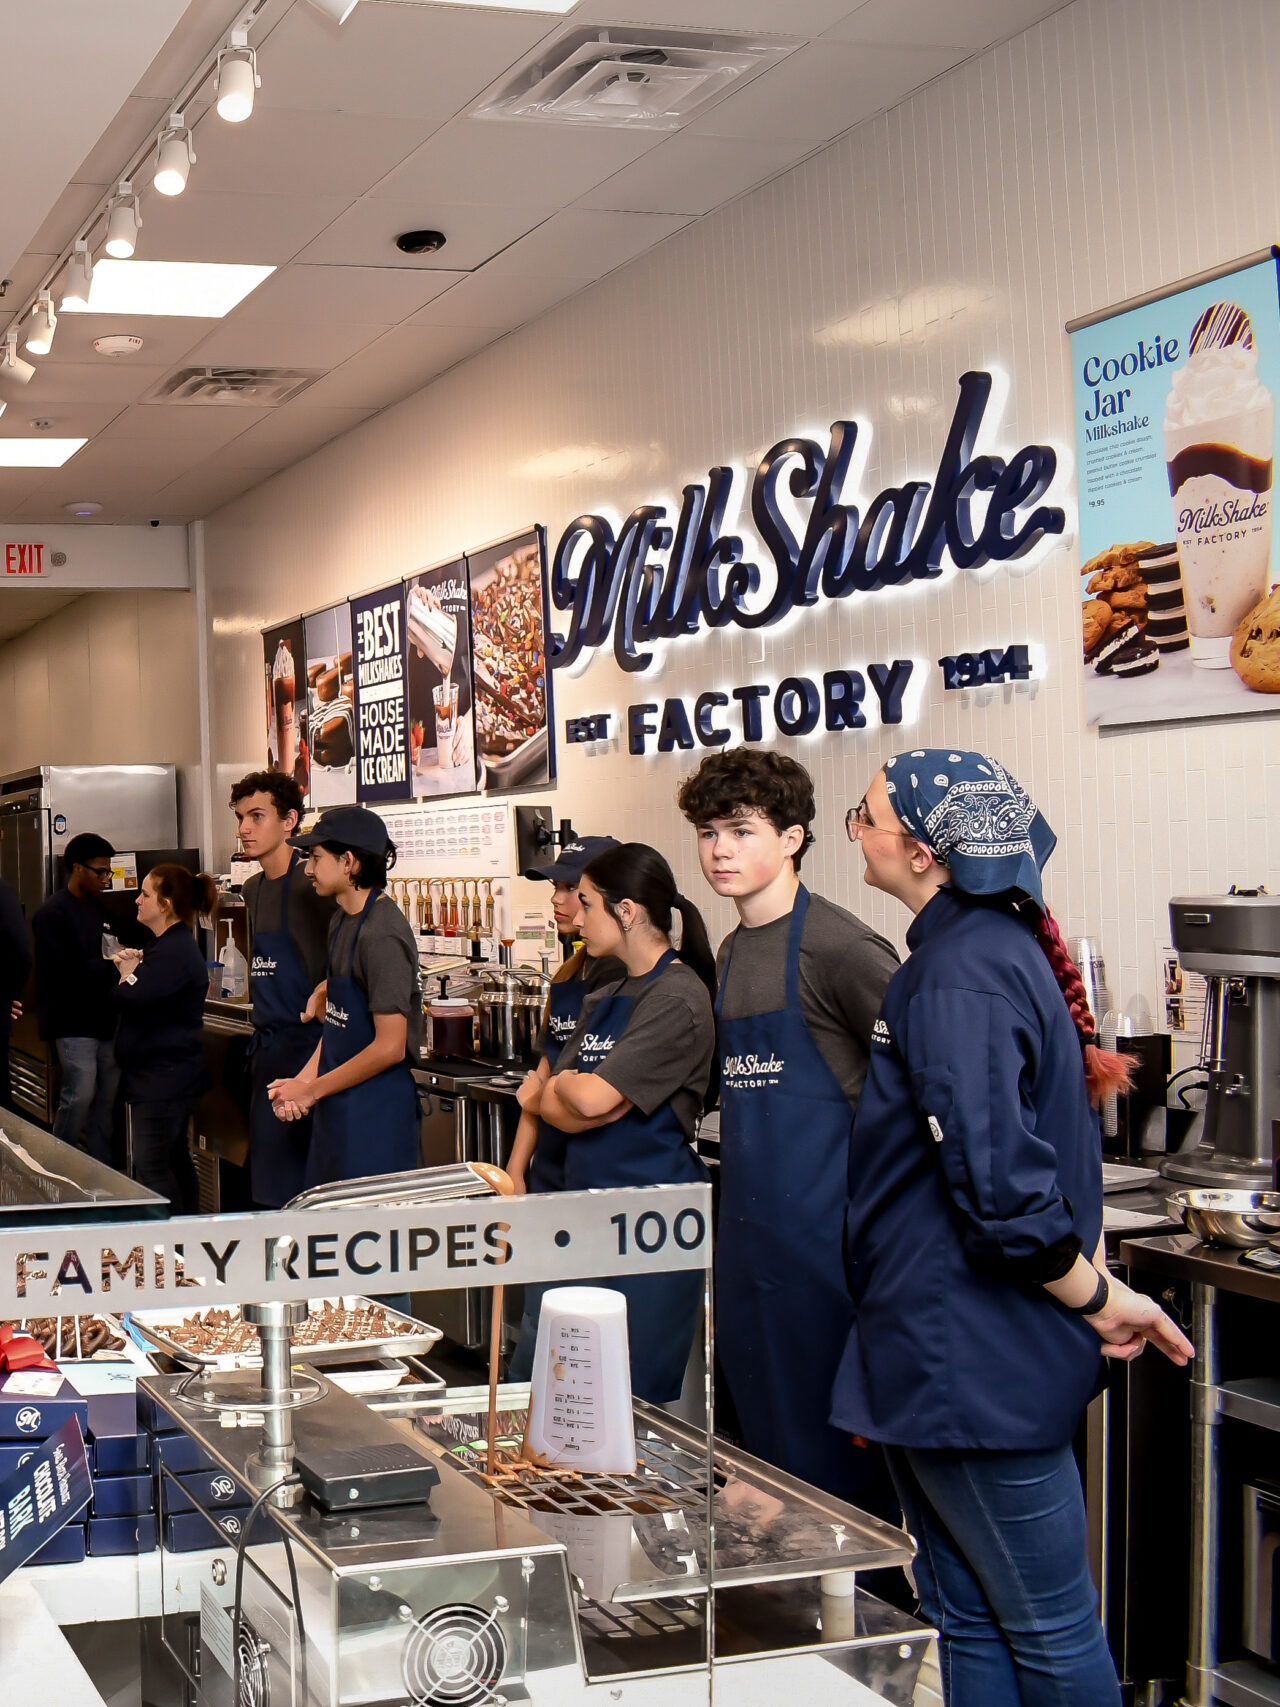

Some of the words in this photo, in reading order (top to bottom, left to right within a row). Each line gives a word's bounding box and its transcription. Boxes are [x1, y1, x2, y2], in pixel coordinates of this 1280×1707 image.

[1083, 335, 1180, 387] Cookie
[1084, 388, 1131, 421] Jar
[1085, 415, 1150, 443] Milkshake
[551, 371, 1066, 672] MilkShake
[1177, 494, 1268, 533] MilkShake
[1197, 530, 1247, 546] FACTORY
[6, 544, 44, 573] EXIT
[363, 599, 401, 661] BEST
[358, 654, 403, 687] MILKSHAKES
[359, 698, 404, 728] HOUSE
[628, 659, 914, 755] FACTORY
[938, 644, 1033, 691] 1914
[359, 723, 405, 756] MADE
[361, 755, 377, 785] ICE
[376, 752, 406, 784] CREAM
[729, 1079, 767, 1089] FACTORY
[16, 1238, 242, 1299] FAMILY
[266, 1220, 515, 1282] RECIPES
[611, 1207, 707, 1257] 100
[33, 1459, 57, 1524] CHOCOLATE
[8, 1484, 35, 1541] BARK
